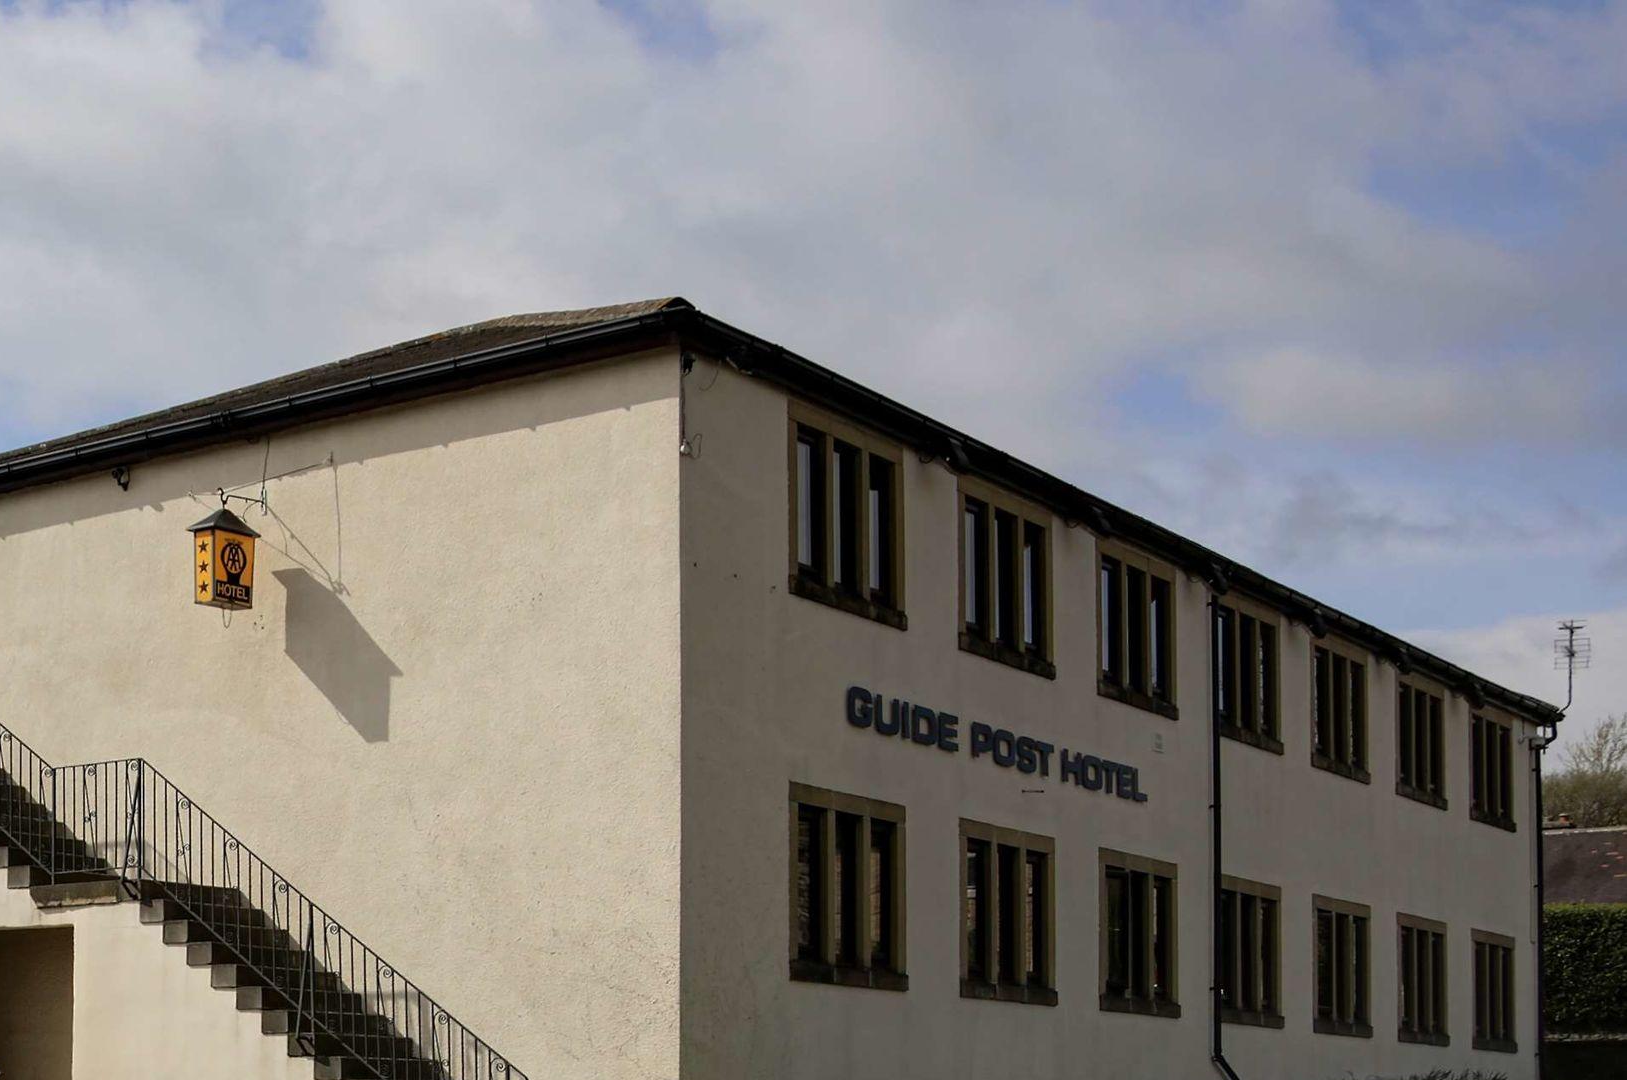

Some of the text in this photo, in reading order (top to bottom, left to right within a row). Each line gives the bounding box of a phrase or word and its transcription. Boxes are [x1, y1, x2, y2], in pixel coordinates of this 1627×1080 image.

[217, 582, 248, 600] HOTEL
[846, 686, 1148, 803] GUIDE POST HOTEL
